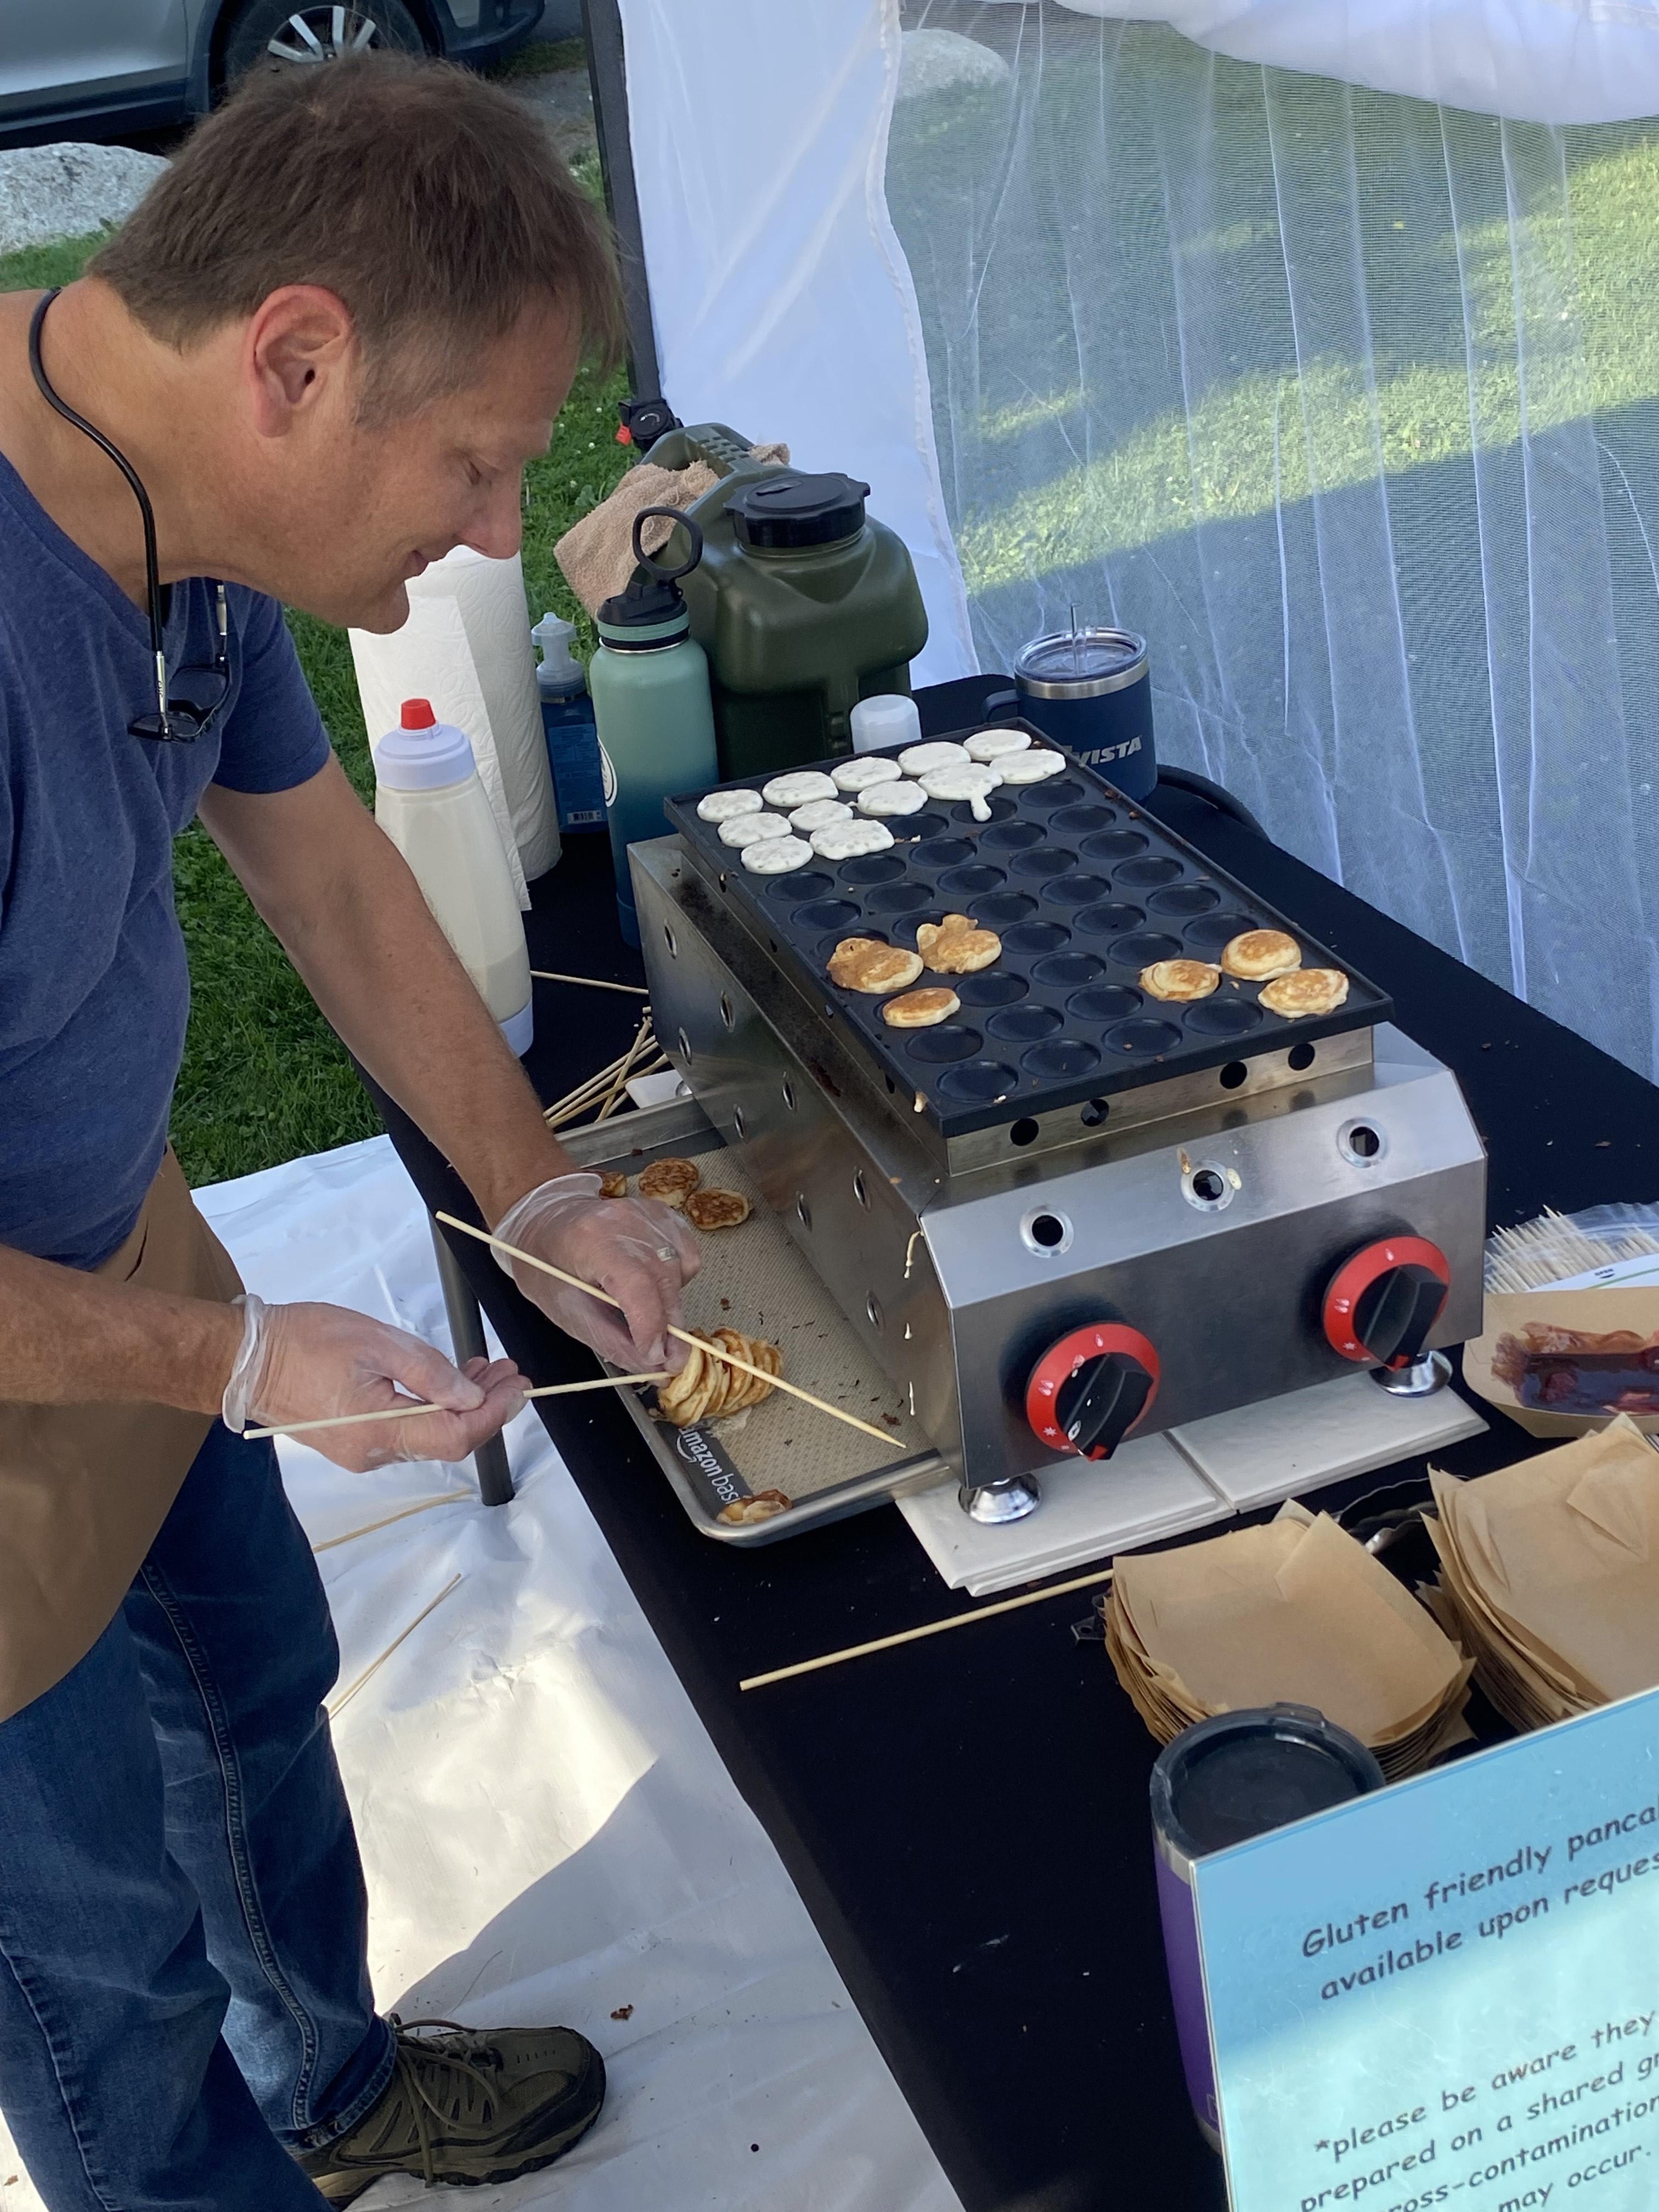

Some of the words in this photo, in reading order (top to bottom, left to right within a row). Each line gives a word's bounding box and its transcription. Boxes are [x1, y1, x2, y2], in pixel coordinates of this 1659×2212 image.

[1302, 1903, 1408, 1957] Gluten
[1424, 1846, 1552, 1911] friendly
[1568, 1795, 1659, 1861] panca
[1321, 1931, 1463, 2000] available
[1479, 1897, 1549, 1939] upon
[1441, 2086, 1476, 2112] be
[1491, 2044, 1577, 2090] aware
[1590, 2010, 1655, 2049] they
[1301, 2139, 1436, 2212] prepared
[1451, 2127, 1483, 2151] on
[1497, 2115, 1513, 2132] a
[1527, 2061, 1624, 2120] shared
[1380, 2095, 1659, 2212] ross-contamination
[1498, 2182, 1554, 2212] may
[1567, 2145, 1651, 2188] occur.
